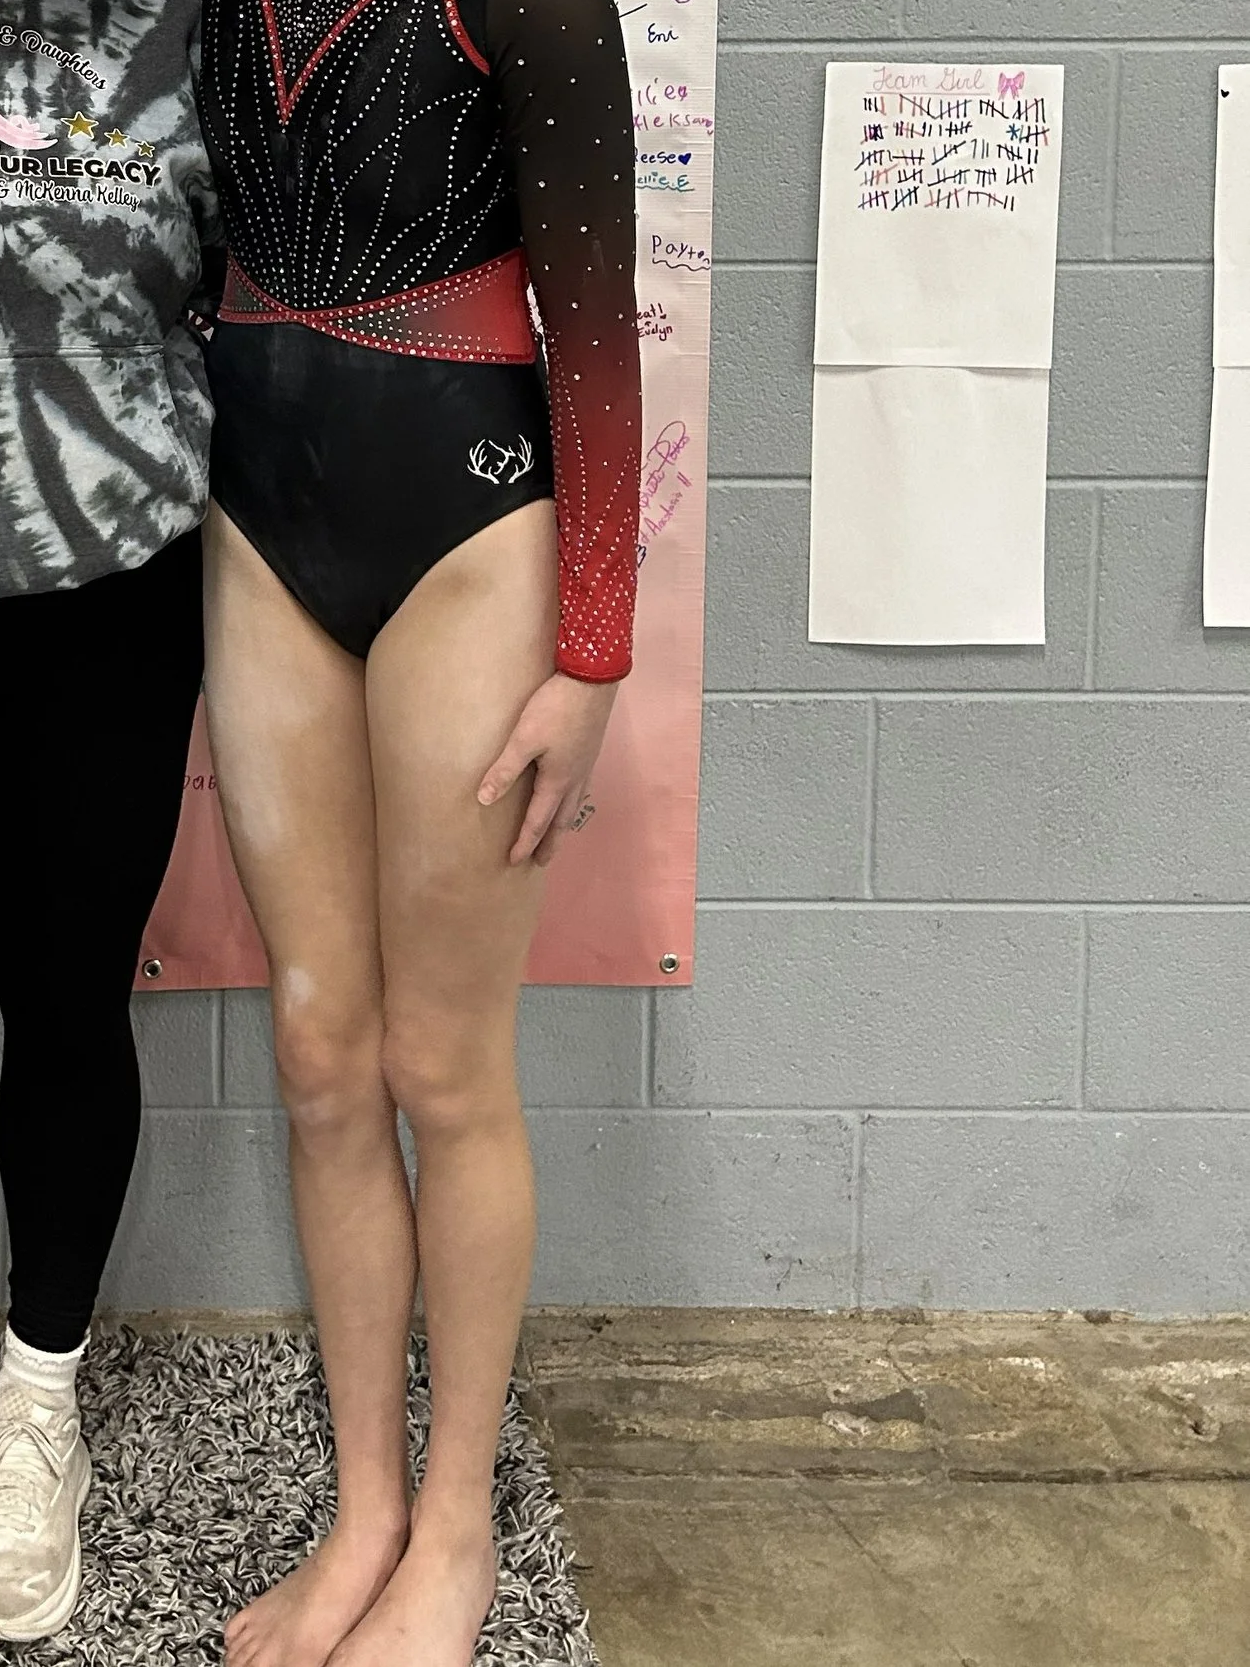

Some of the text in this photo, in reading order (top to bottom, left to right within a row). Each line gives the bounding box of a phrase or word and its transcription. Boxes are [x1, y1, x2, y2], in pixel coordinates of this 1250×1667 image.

[19, 29, 107, 91] Daughters
[871, 66, 986, 91] Team Girl
[49, 158, 162, 187] LEGACY
[15, 181, 93, 205] McKenna
[96, 185, 142, 213] Kelley
